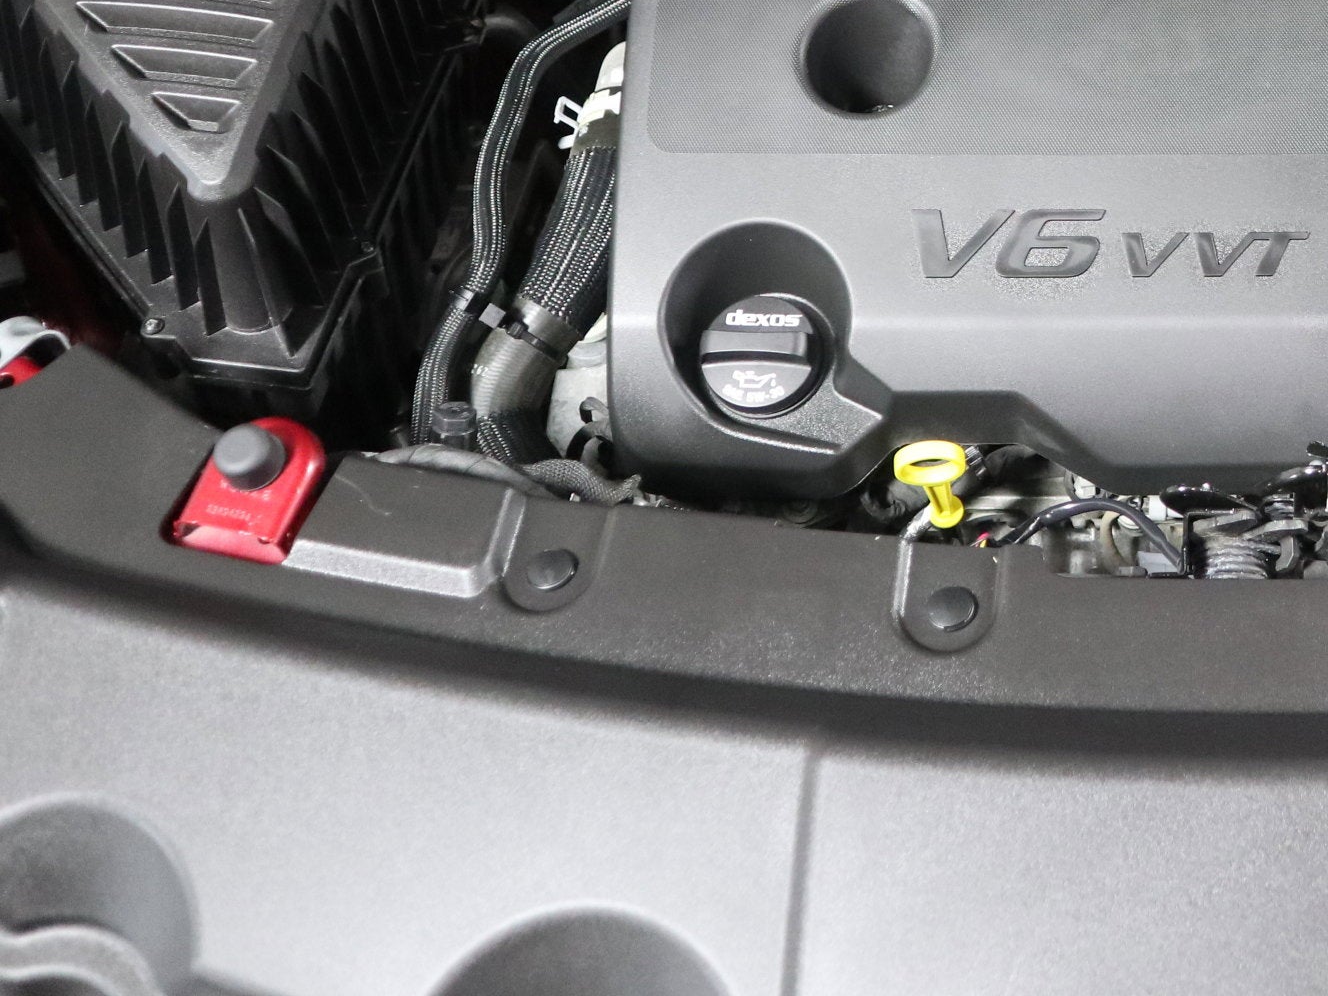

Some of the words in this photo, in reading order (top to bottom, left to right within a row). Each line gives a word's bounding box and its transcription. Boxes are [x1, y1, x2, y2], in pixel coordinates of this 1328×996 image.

[911, 209, 1107, 278] V6
[1119, 231, 1311, 278] VVT
[725, 308, 804, 327] dexos
